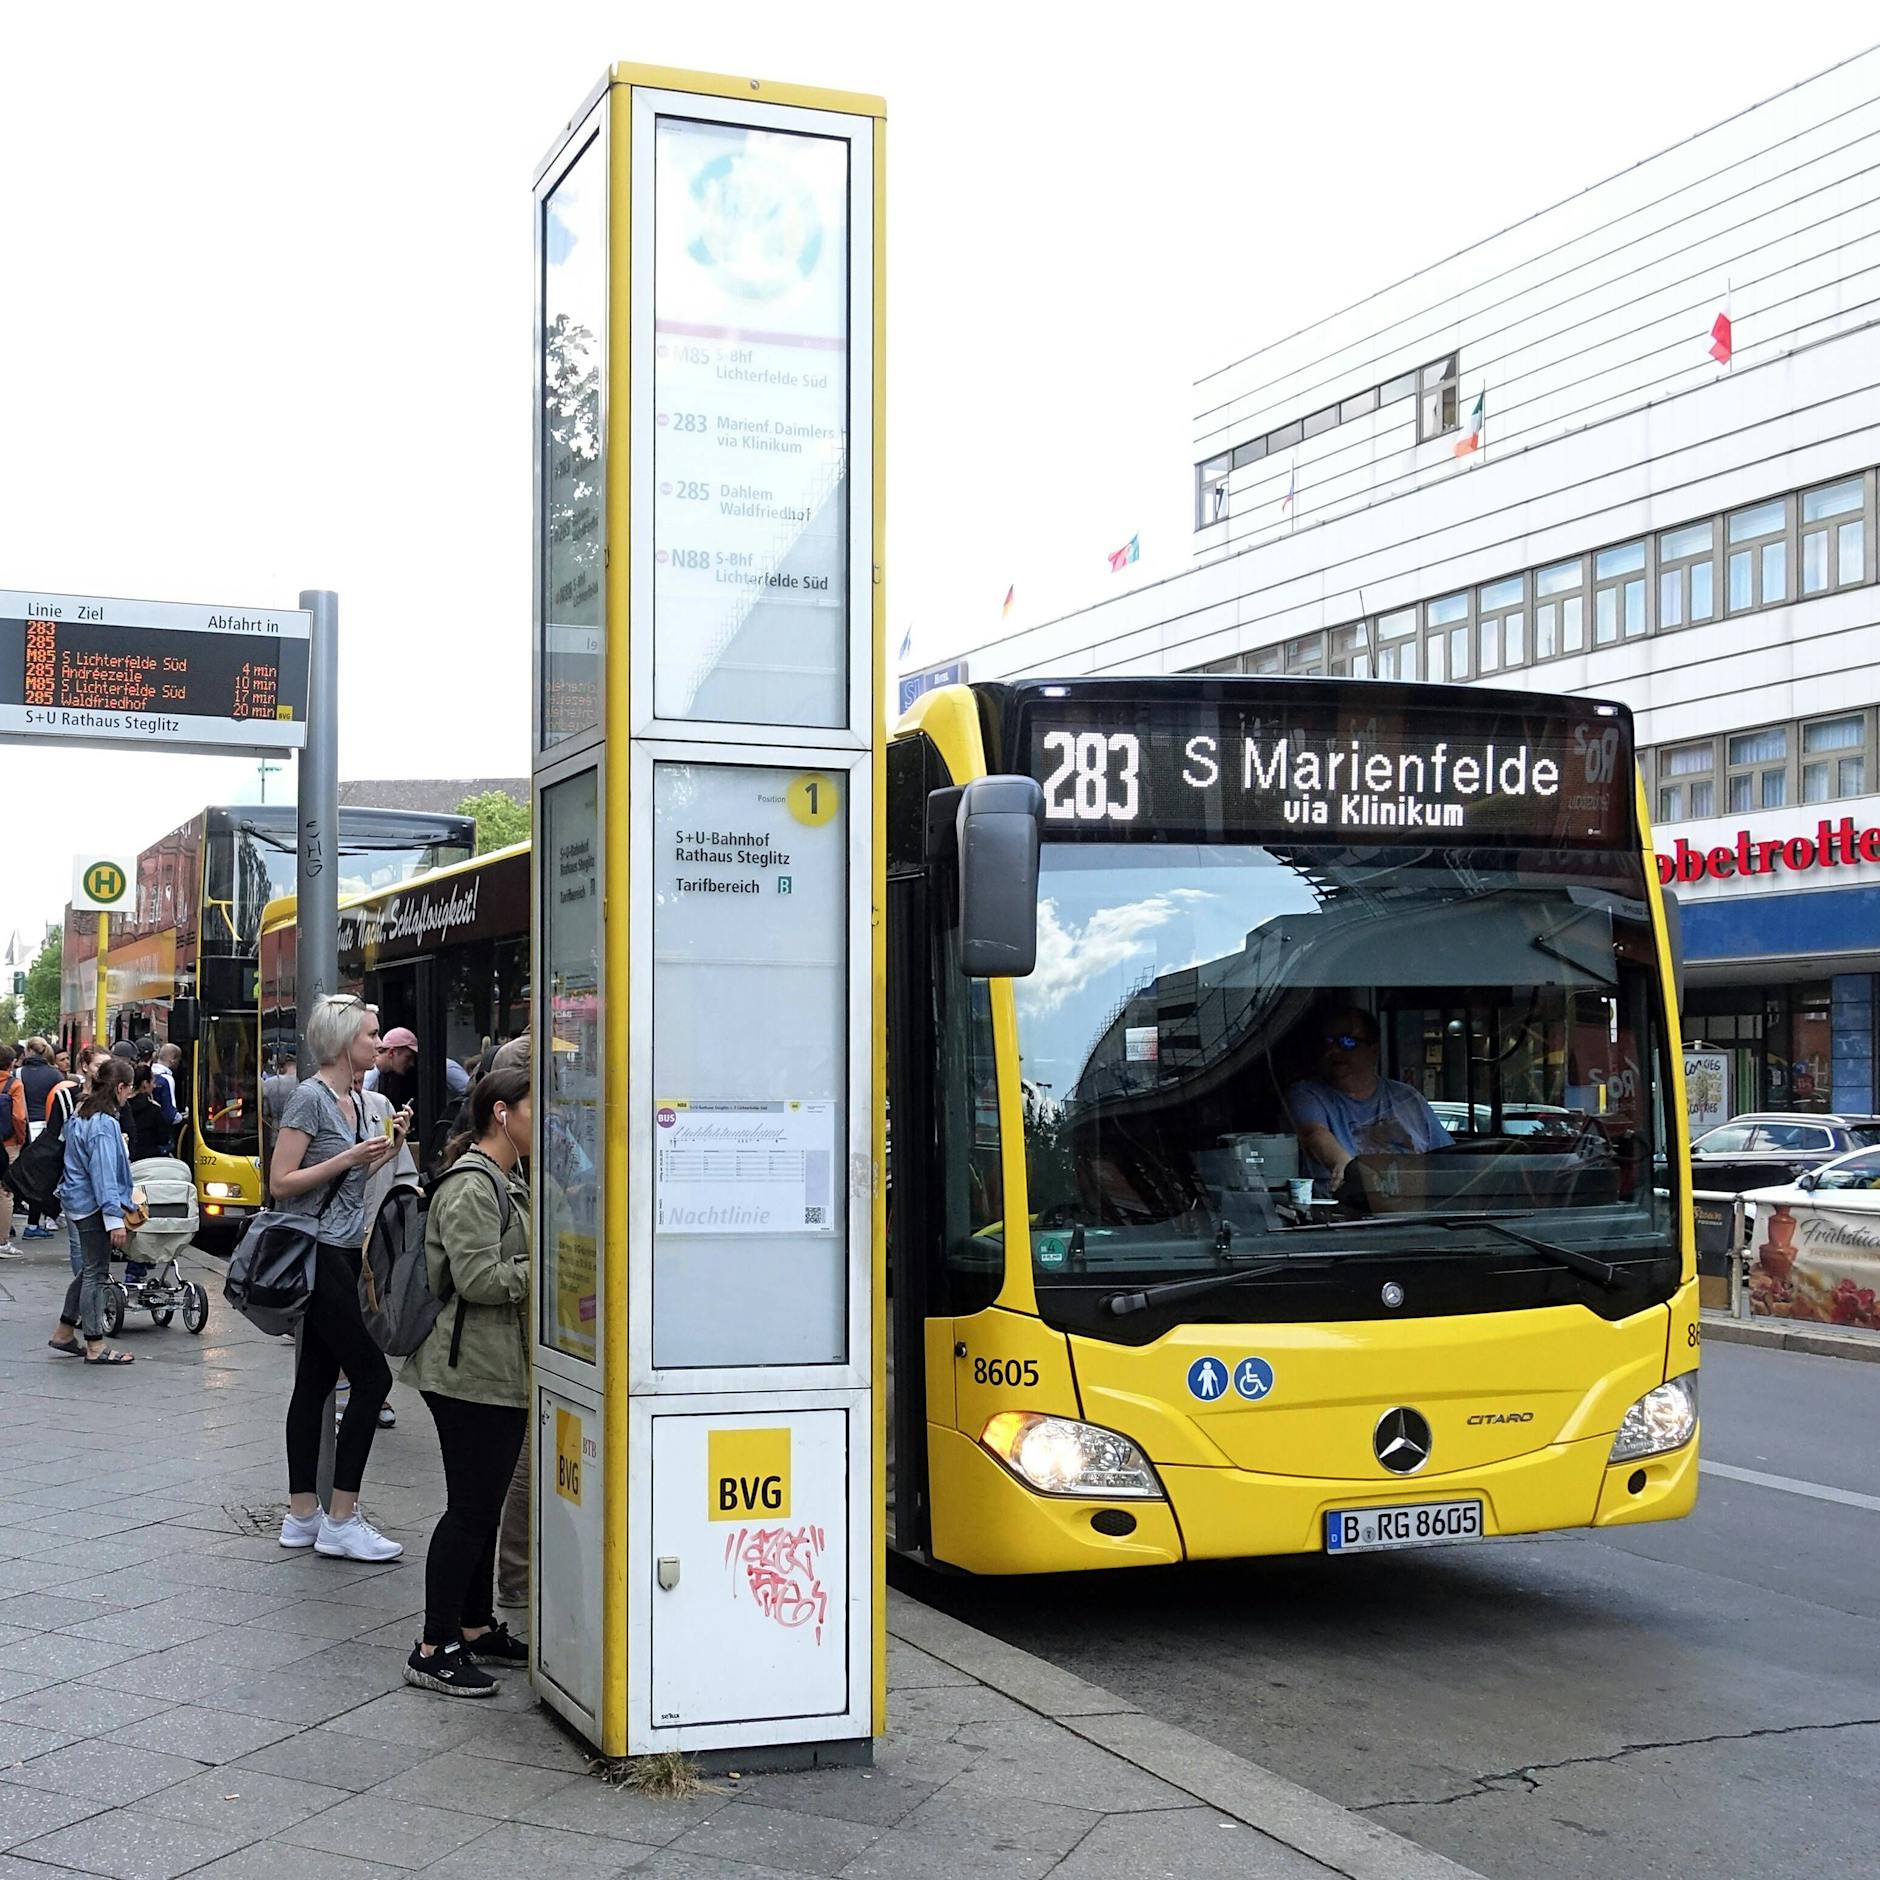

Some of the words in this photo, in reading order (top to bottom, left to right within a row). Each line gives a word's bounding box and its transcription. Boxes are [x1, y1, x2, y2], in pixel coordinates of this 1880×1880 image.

[716, 365, 799, 386] Lichterfelde
[802, 374, 828, 389] Süd
[673, 412, 708, 433] 283
[717, 434, 738, 447] via
[742, 435, 803, 454] Klinikum
[676, 480, 711, 501] 285
[720, 484, 773, 501] Dahlem
[720, 502, 812, 522] Waldfriedhof
[672, 548, 711, 570] N88
[716, 551, 754, 567] S-Bhf
[715, 569, 799, 589] Lichterfelde
[803, 576, 829, 590] Süd
[27, 620, 56, 635] 283
[28, 602, 62, 618] Linie
[78, 605, 104, 621] Ziel
[208, 615, 262, 632] Abfahrt
[267, 618, 279, 633] in
[27, 635, 56, 649] 285
[26, 648, 56, 664] M85
[62, 651, 71, 665] S
[76, 651, 157, 671] Lichterfelde
[163, 656, 188, 673] Süd
[242, 662, 251, 675] 4
[254, 664, 278, 677] min
[26, 662, 55, 678] 285
[235, 676, 250, 690] 10
[253, 678, 277, 691] min
[26, 676, 56, 691] M85
[61, 679, 70, 693] S
[75, 680, 157, 698] Lichterfelde
[162, 684, 187, 700] Süd
[235, 690, 250, 703] 17
[252, 692, 276, 705] min
[25, 690, 53, 705] 285
[60, 693, 148, 711] Waldfriedhof
[233, 703, 249, 717] 20
[251, 705, 276, 719] min
[26, 710, 57, 725] S+U
[62, 712, 121, 729] Rathaus
[125, 716, 180, 734] Steglitz
[1043, 731, 1139, 820] 283
[1182, 735, 1219, 789] S
[1243, 737, 1560, 796] Marienfelde
[757, 793, 787, 804] Position
[804, 782, 818, 815] 1
[1283, 796, 1328, 824] via
[1340, 794, 1465, 828] Klinikum
[676, 831, 771, 847] S+U-Bahnhof
[676, 849, 733, 864] Rathaus
[737, 851, 791, 868] Steglitz
[676, 878, 760, 894] Tarifbereich
[779, 877, 791, 893] B
[657, 1114, 675, 1122] BUS
[669, 1206, 770, 1226] Nachtlinie
[974, 1357, 1039, 1387] 8605
[1467, 1412, 1534, 1425] CITARO
[560, 1454, 579, 1495] BVG
[719, 1475, 782, 1511] BVG
[1344, 1516, 1360, 1543] B
[1378, 1512, 1410, 1541] RG
[1416, 1506, 1476, 1537] 8605
